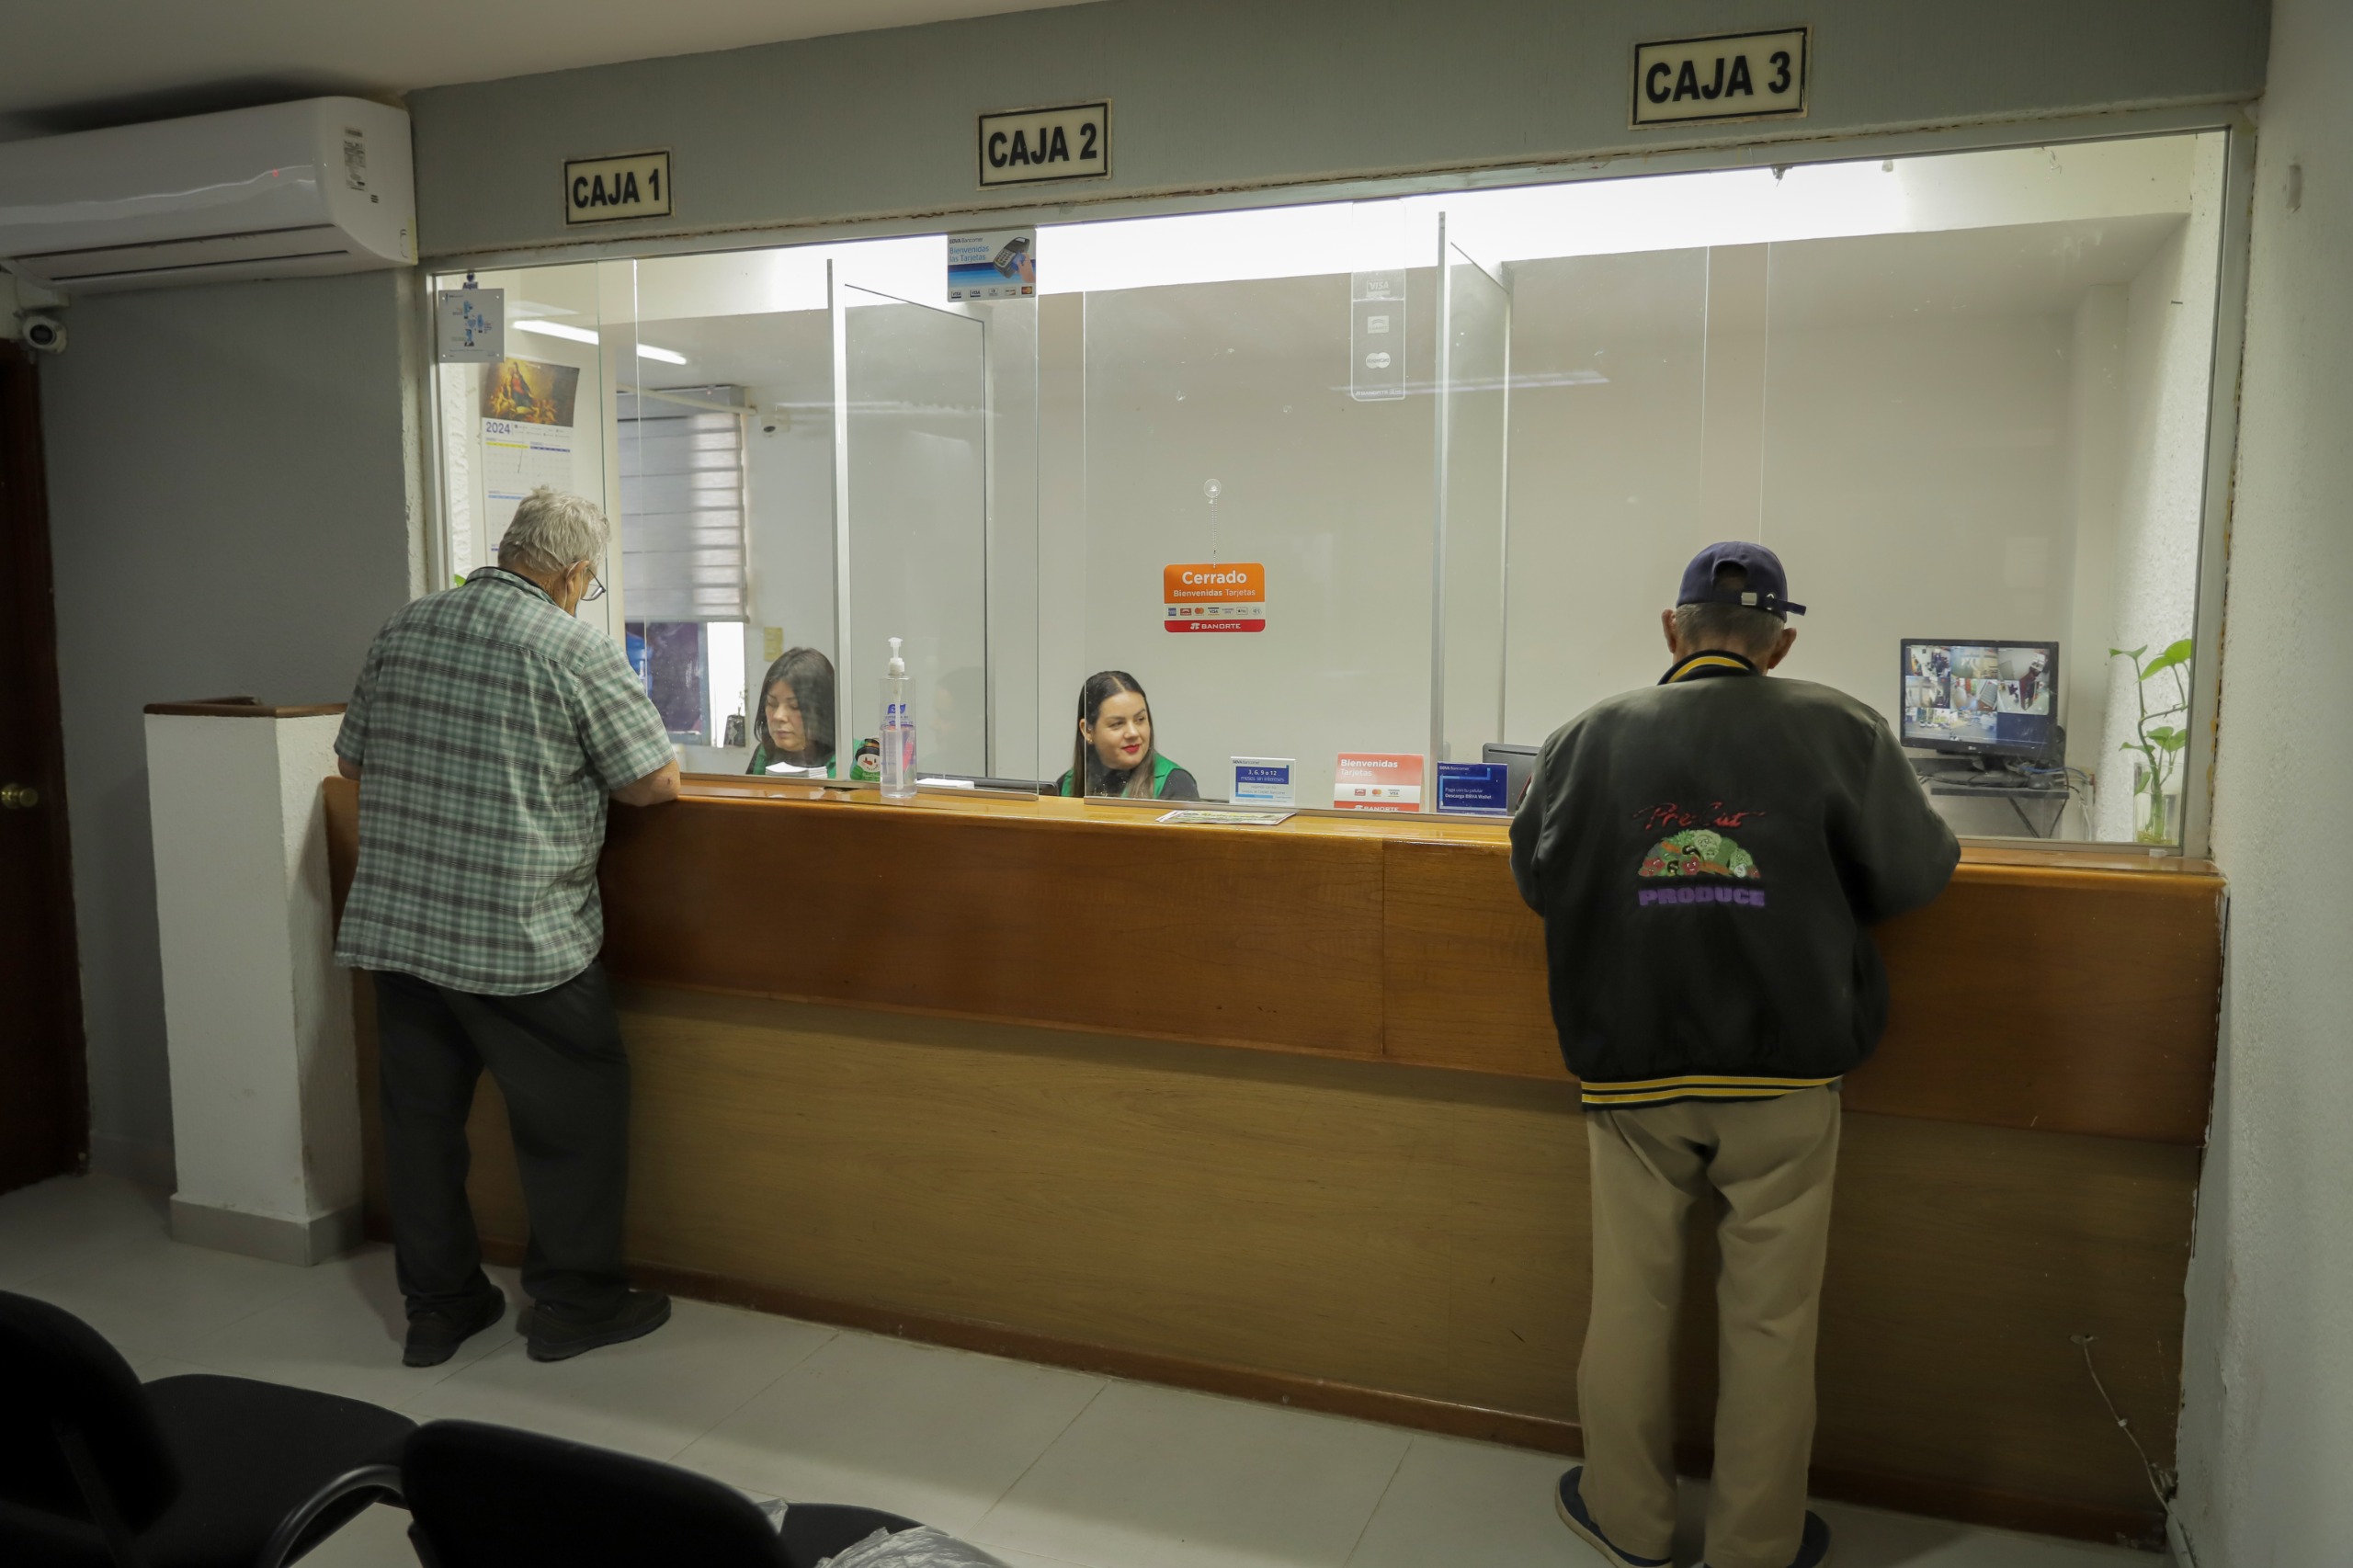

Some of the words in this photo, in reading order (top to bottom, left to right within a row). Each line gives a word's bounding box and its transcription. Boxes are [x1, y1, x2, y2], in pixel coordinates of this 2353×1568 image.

[1646, 55, 1754, 104] CAJA
[1768, 51, 1791, 94] 3
[988, 126, 1070, 168] CAJA
[1080, 122, 1097, 160] 2
[573, 172, 641, 209] CAJA
[649, 168, 659, 201] 1
[949, 244, 990, 255] Bienvenidas
[961, 254, 986, 263] Tarjetas
[1370, 281, 1390, 290] VISA
[485, 421, 511, 435] 2024
[1182, 570, 1247, 585] Cerrado
[1173, 589, 1222, 597] Bienvenidas
[1224, 588, 1256, 597] Tarjetas
[1340, 758, 1398, 768] Bienvenidas
[1341, 768, 1372, 777] Tarjetas
[1638, 886, 1766, 906] PRODUCE
